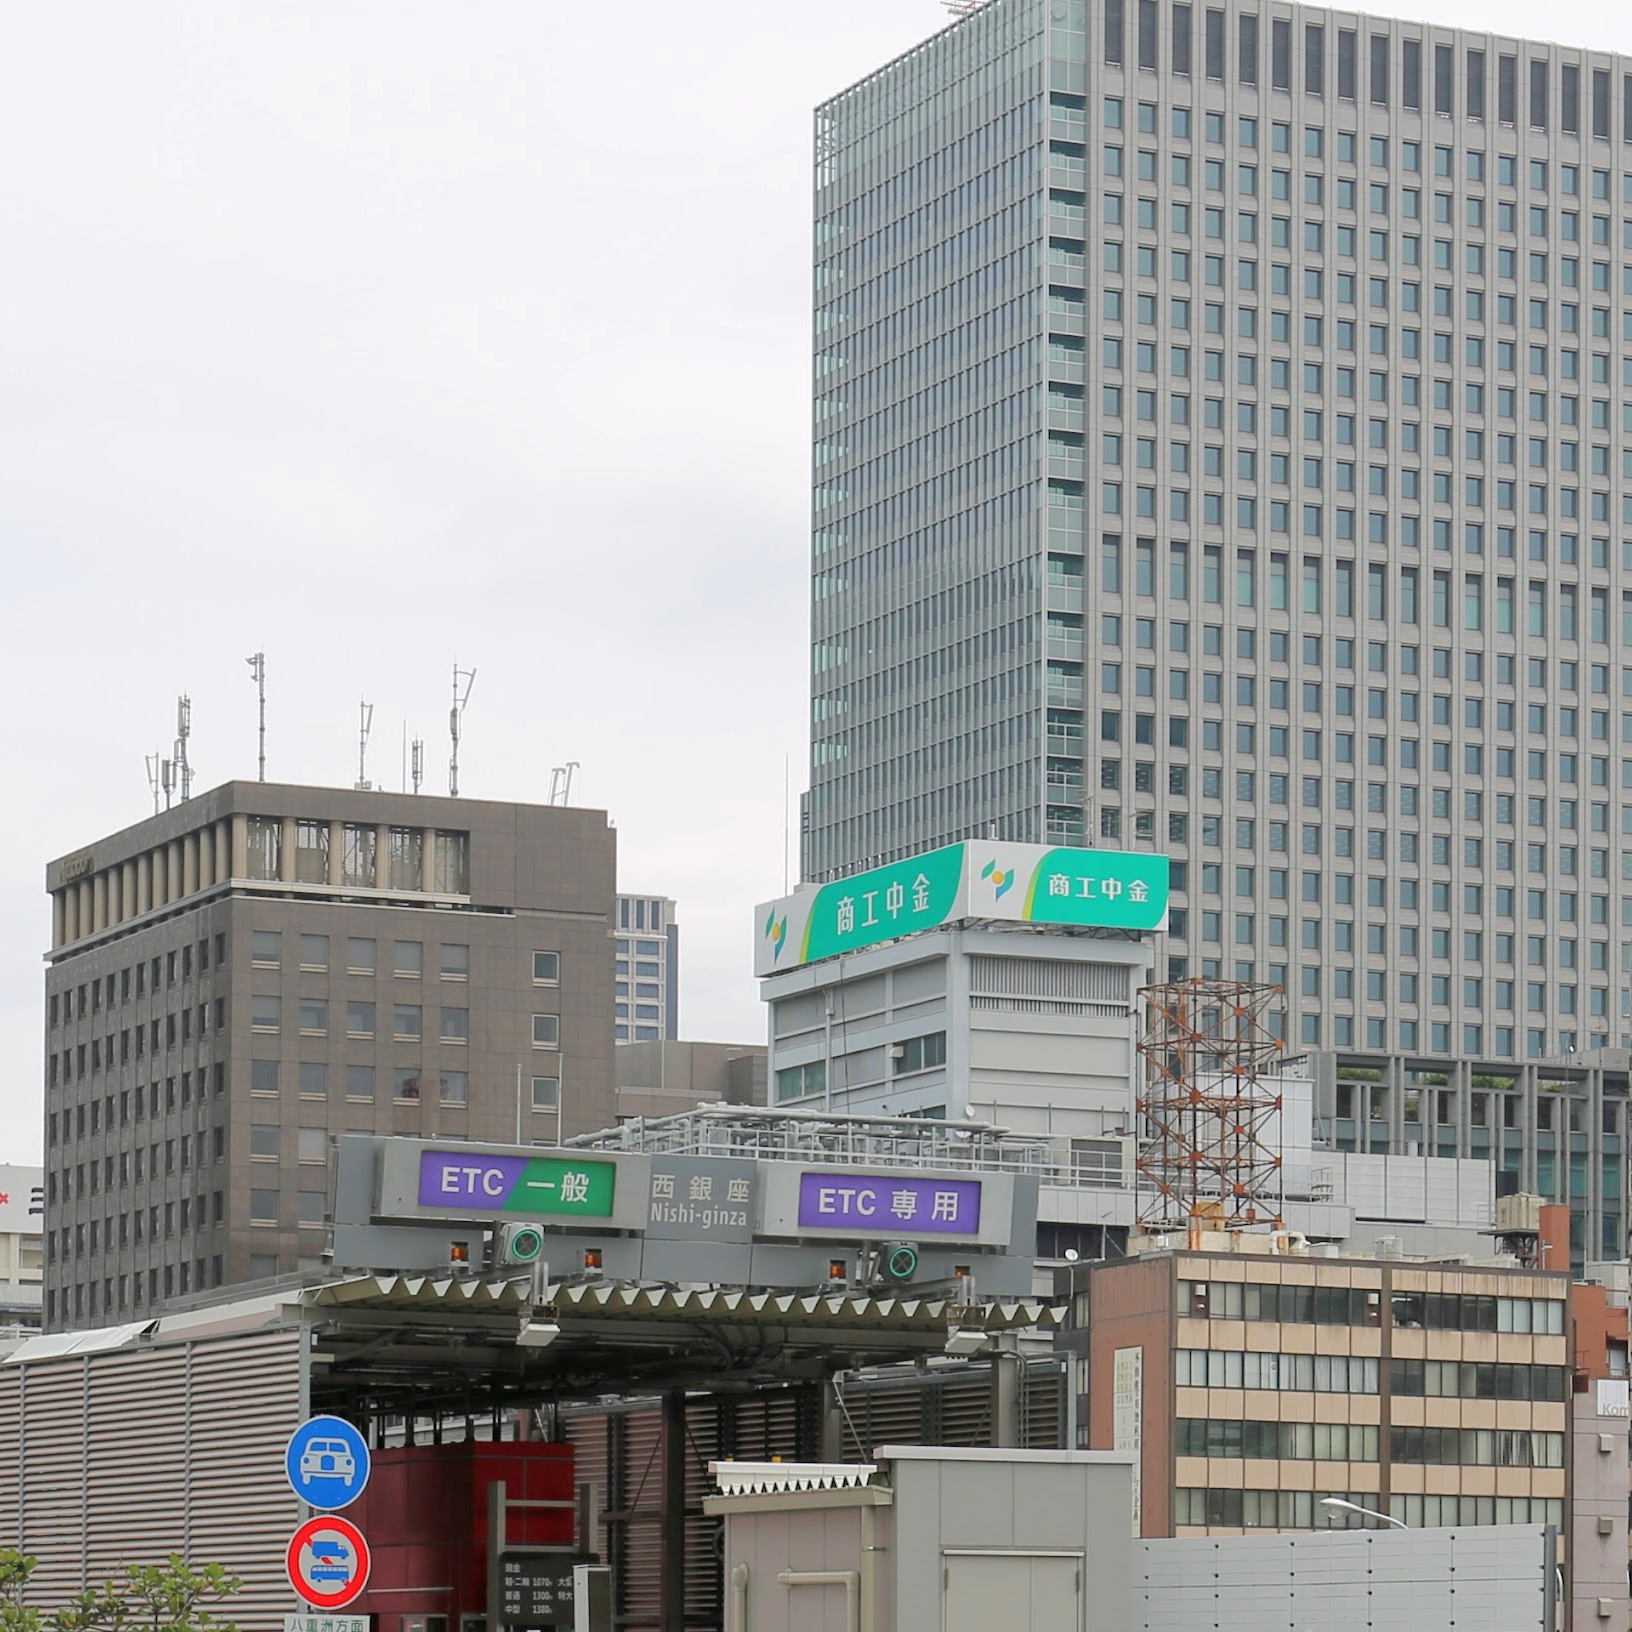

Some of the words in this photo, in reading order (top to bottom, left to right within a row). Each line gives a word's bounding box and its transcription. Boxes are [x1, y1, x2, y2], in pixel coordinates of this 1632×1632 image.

[1048, 873, 1150, 903] 商工中金
[835, 872, 931, 936] 商工中金
[440, 1166, 505, 1196] ETC
[526, 1171, 590, 1203] 一般
[652, 1173, 751, 1203] 西銀座
[650, 1202, 748, 1229] Nishi-ginza
[819, 1187, 877, 1216] ETC
[890, 1189, 959, 1222] 専用
[1602, 1403, 1630, 1416] Kom
